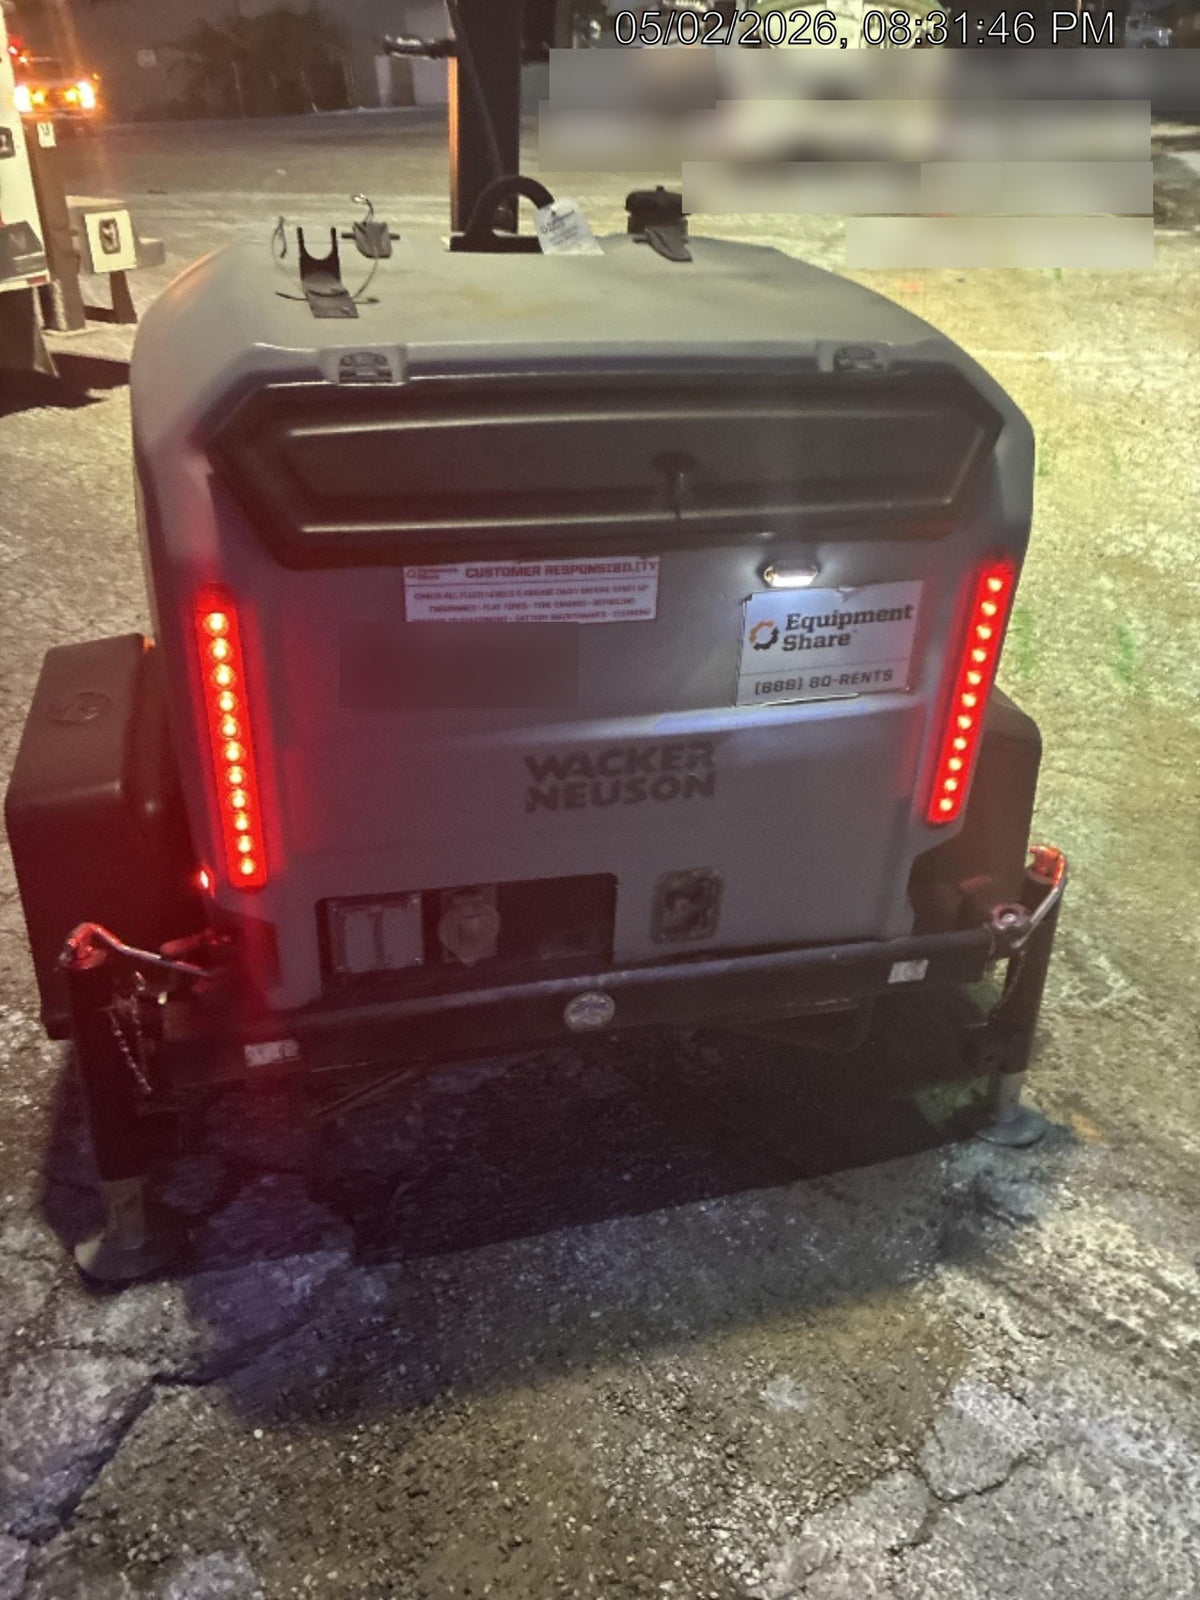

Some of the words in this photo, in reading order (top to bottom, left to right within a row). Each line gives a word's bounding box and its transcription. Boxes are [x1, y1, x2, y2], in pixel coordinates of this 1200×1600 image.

[465, 566, 541, 578] CUSTOMER
[544, 561, 658, 575] RESPONSIBILITY
[785, 604, 914, 633] Equipment
[782, 633, 851, 651] Share
[808, 669, 893, 689] 80-RENTS
[523, 741, 715, 782] WACKER
[525, 772, 716, 813] NEUSON
